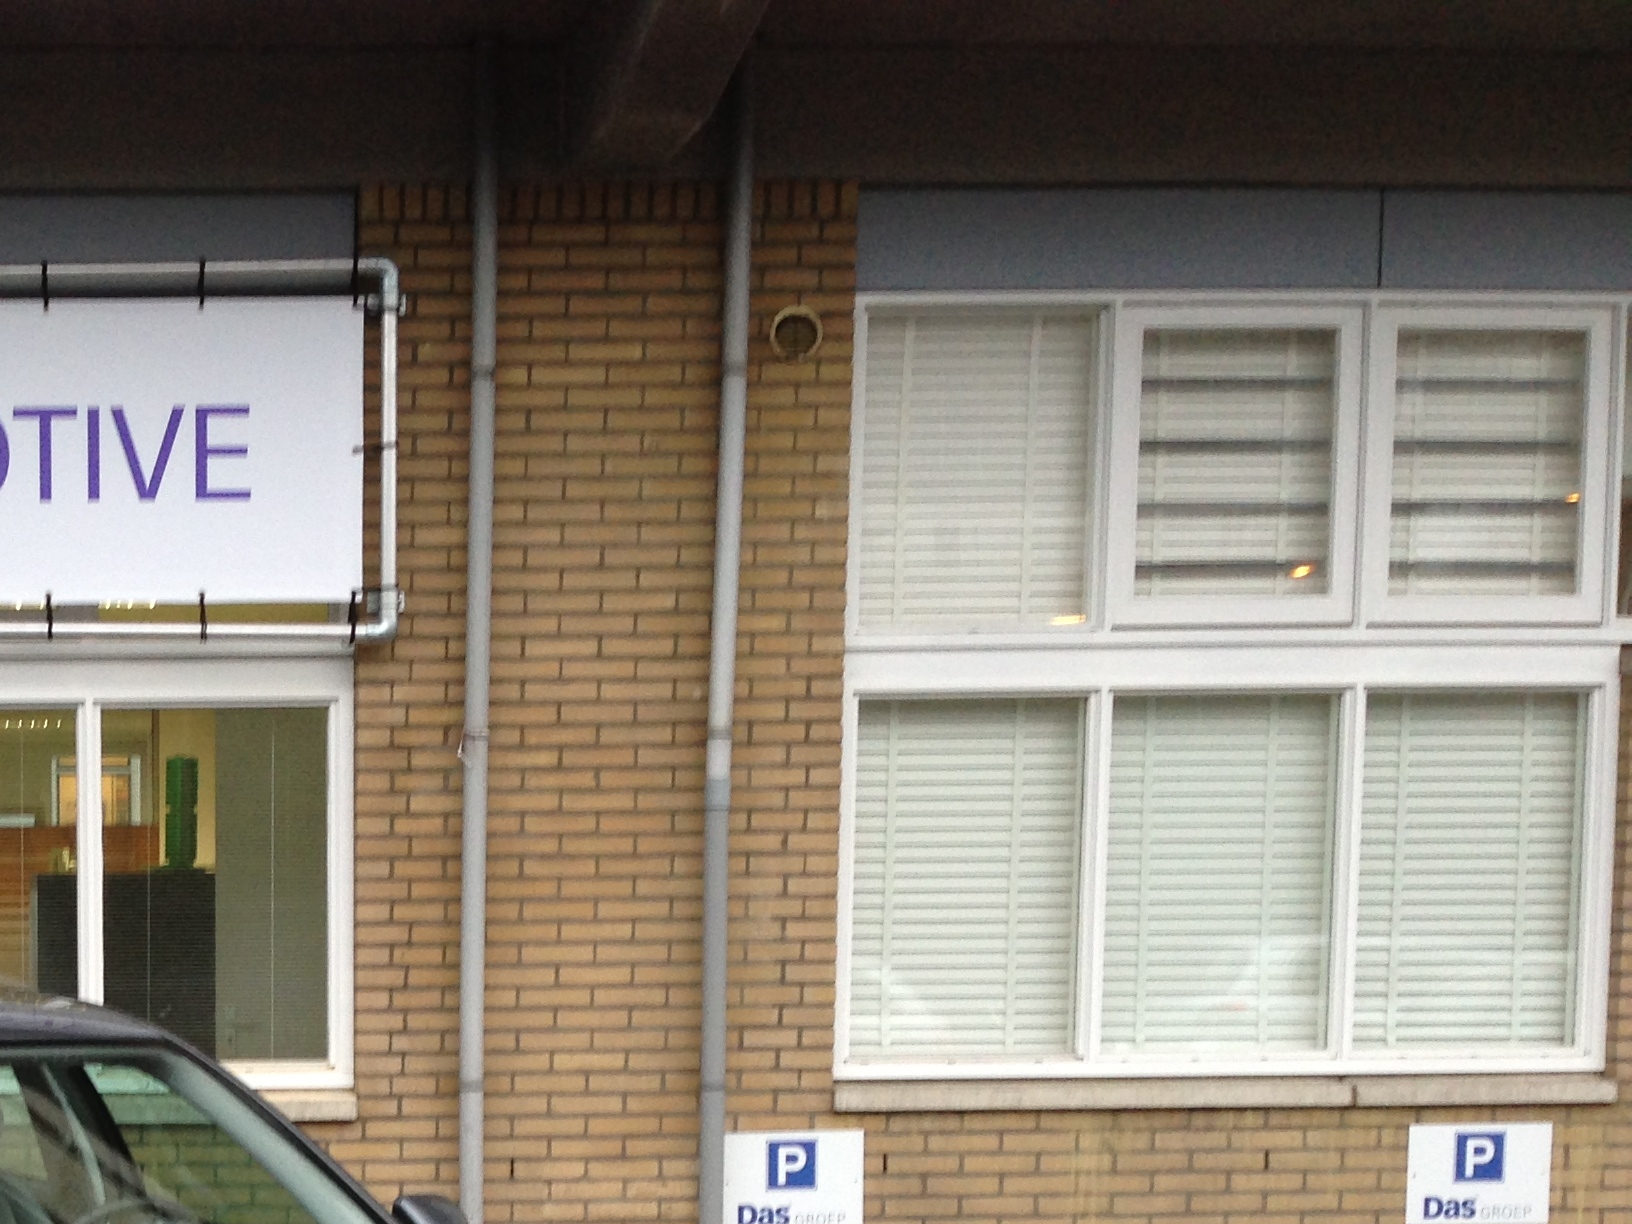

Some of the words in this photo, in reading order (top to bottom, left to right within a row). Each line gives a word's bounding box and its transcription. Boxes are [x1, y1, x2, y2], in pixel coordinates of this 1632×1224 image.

[777, 1144, 807, 1186] P
[1465, 1138, 1495, 1178] P
[1423, 1195, 1476, 1220] Das
[1480, 1203, 1532, 1219] GROEP
